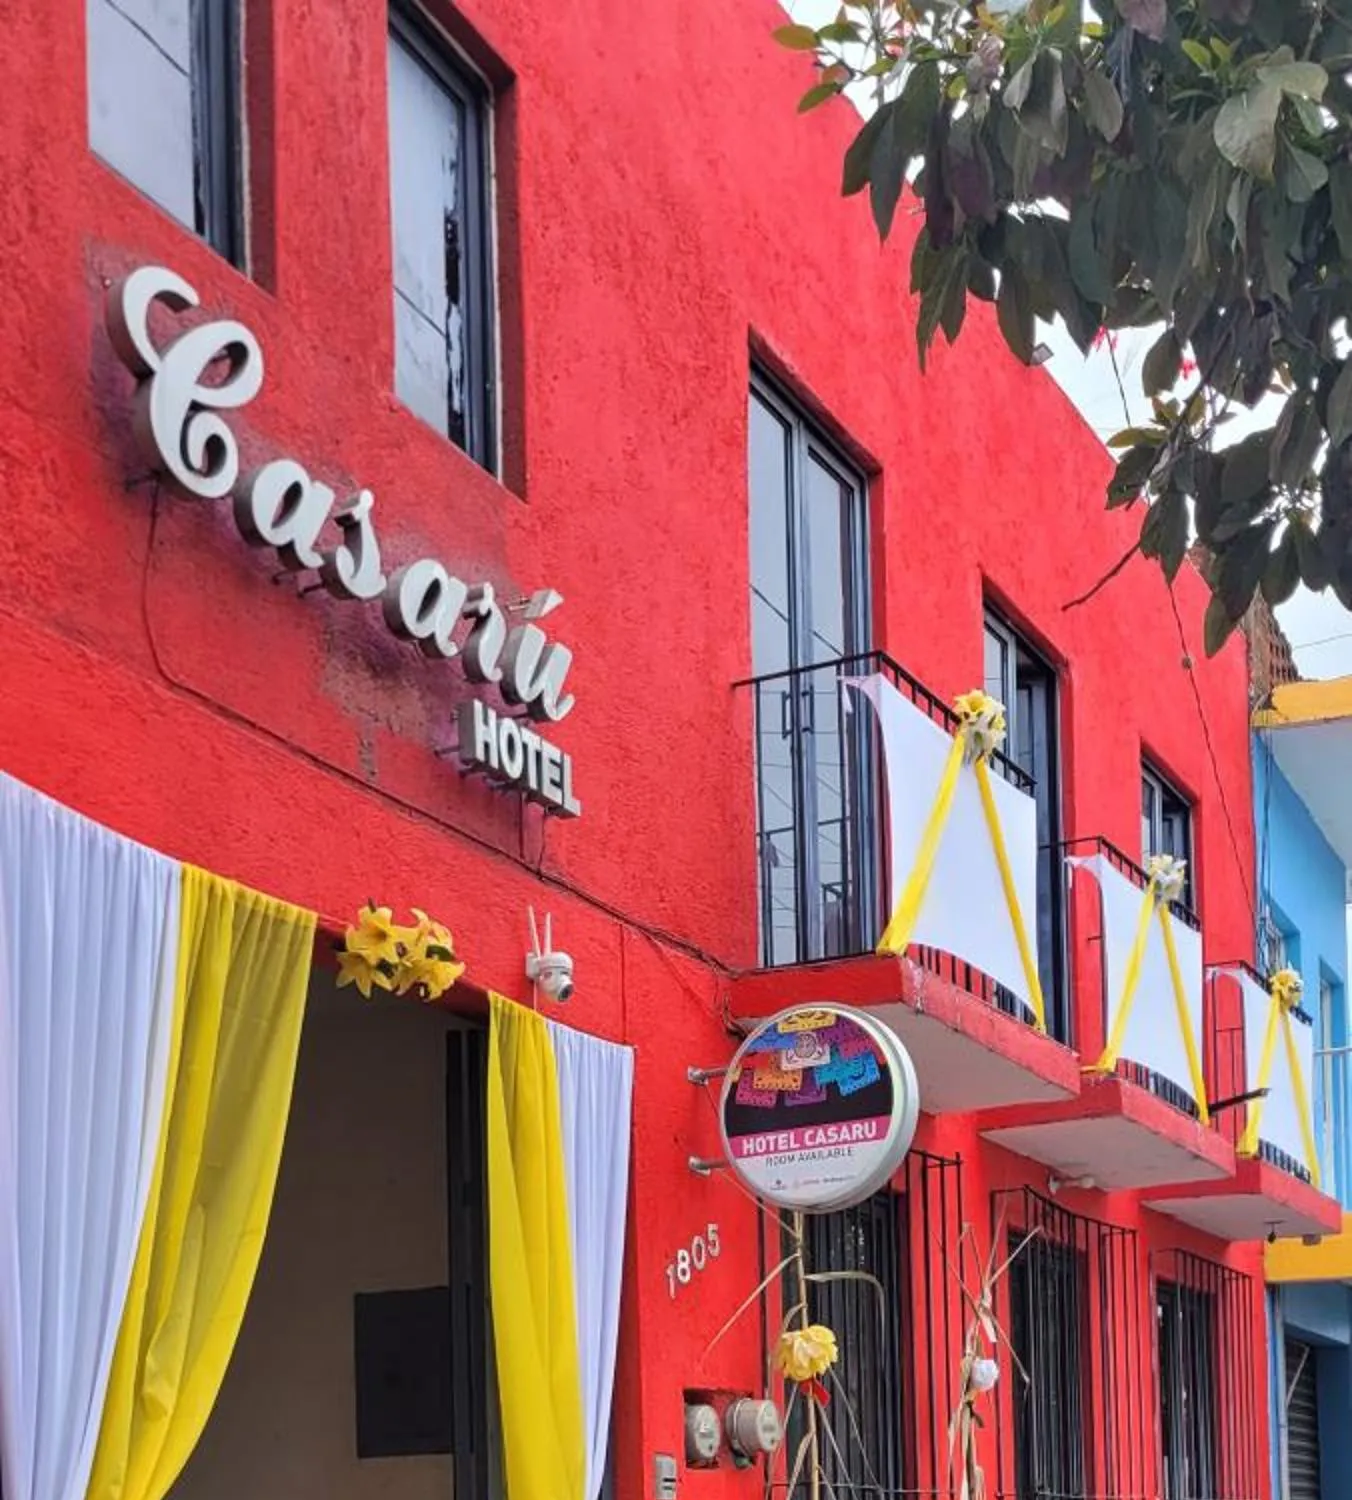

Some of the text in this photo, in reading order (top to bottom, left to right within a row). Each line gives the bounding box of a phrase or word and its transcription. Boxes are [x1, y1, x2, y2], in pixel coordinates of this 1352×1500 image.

[118, 265, 575, 722] Casarú
[470, 698, 581, 819] HOTEL
[742, 1121, 877, 1155] HOTEL CASARU
[765, 1147, 854, 1168] ROOM AVAILABLE
[666, 1223, 720, 1300] 1805
